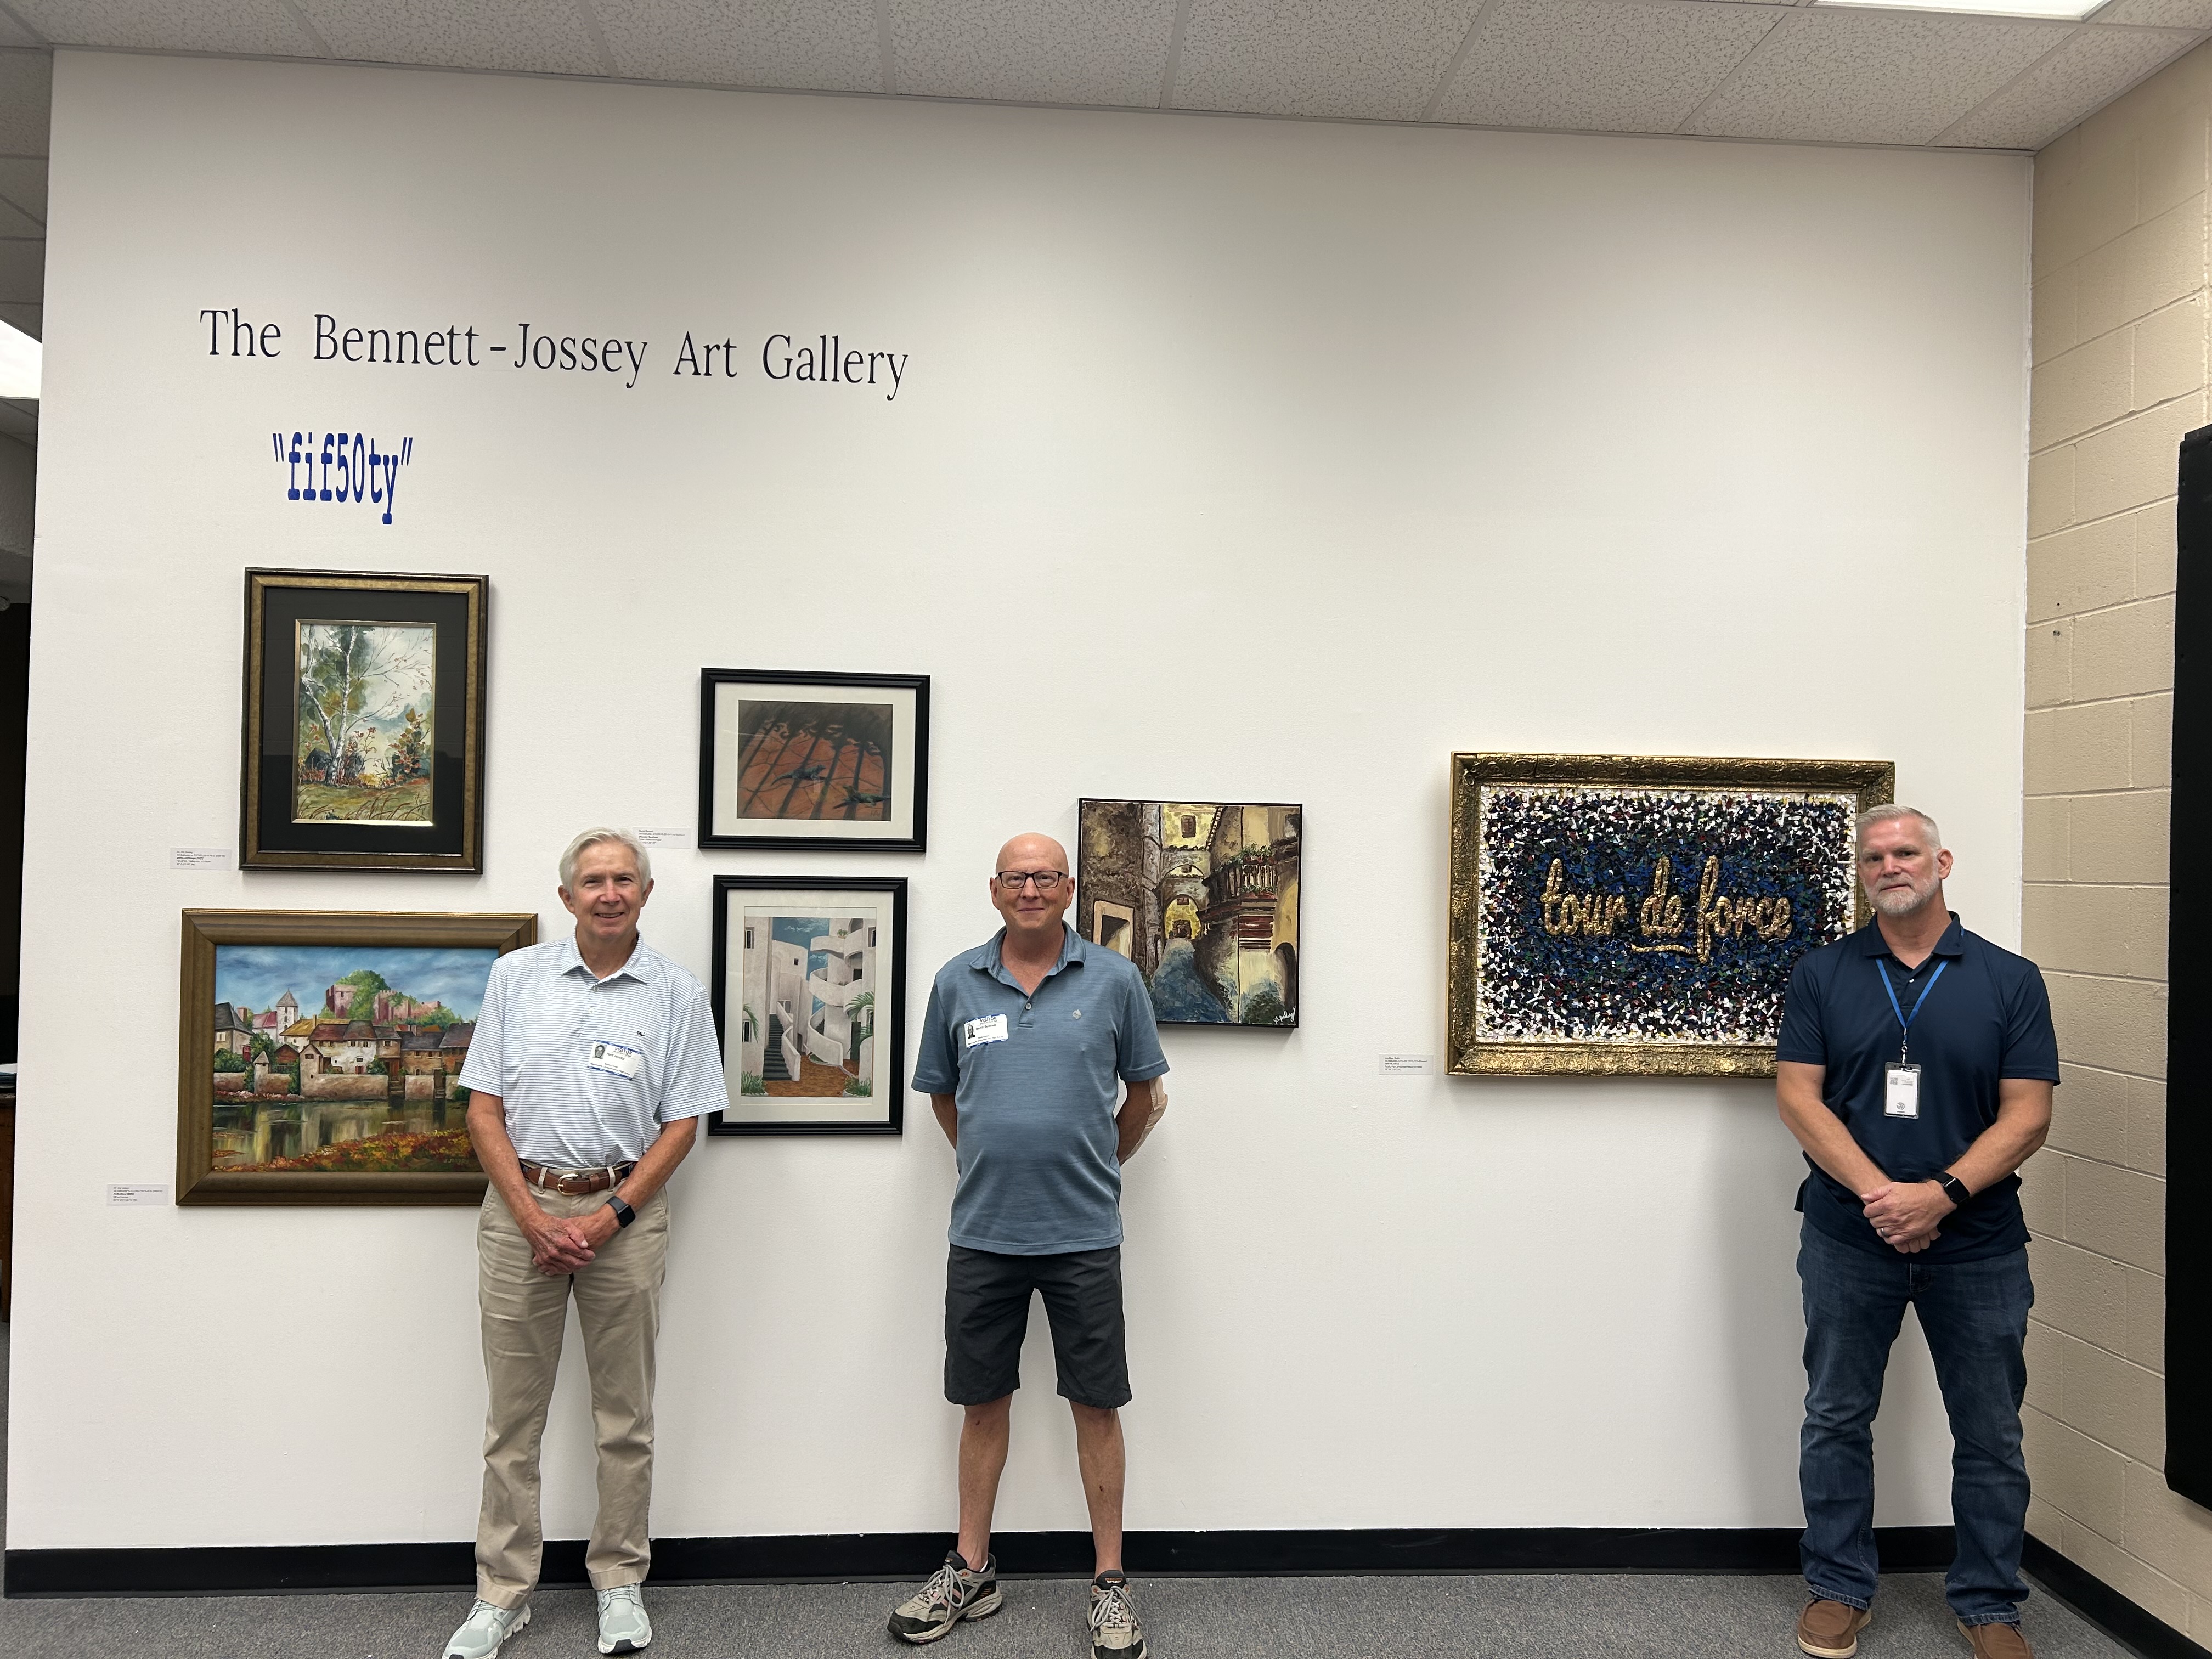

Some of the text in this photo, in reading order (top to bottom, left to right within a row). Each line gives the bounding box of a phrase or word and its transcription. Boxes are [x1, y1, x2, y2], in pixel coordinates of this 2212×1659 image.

[200, 308, 281, 357] The
[673, 331, 737, 378] Art
[763, 334, 909, 401] Gallery
[1539, 855, 1793, 964] tour de force
[614, 1046, 633, 1055] VISITOR
